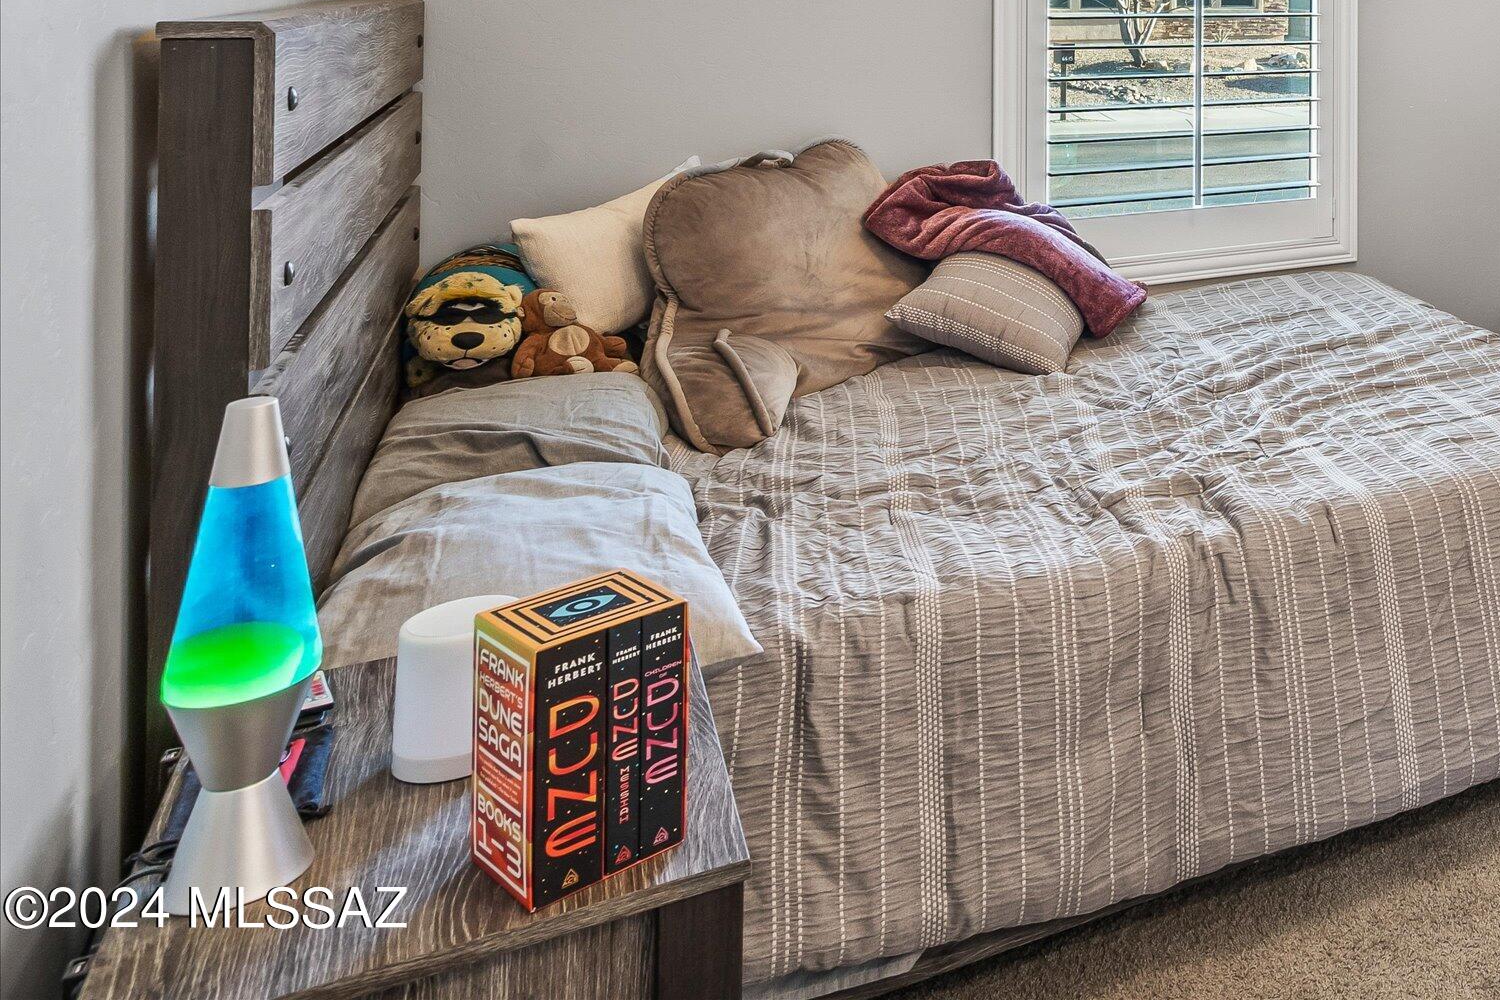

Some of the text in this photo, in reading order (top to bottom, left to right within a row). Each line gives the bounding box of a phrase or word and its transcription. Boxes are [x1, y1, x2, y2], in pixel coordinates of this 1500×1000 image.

[615, 645, 637, 657] FRANK
[645, 633, 682, 651] HERBERT
[650, 627, 678, 641] FRANK
[480, 648, 524, 692] FRANK
[547, 662, 603, 689] HERBERT
[554, 652, 596, 675] FRANK
[612, 650, 640, 665] HERBERT
[479, 671, 523, 709] HERBERT'S
[479, 688, 523, 738] DUNE
[612, 678, 639, 761] DUNE
[645, 678, 679, 784] DUNE
[479, 716, 522, 768] SAGA
[545, 695, 600, 857] DUNE
[478, 792, 521, 843] BOOKS
[478, 817, 521, 879] 1-3
